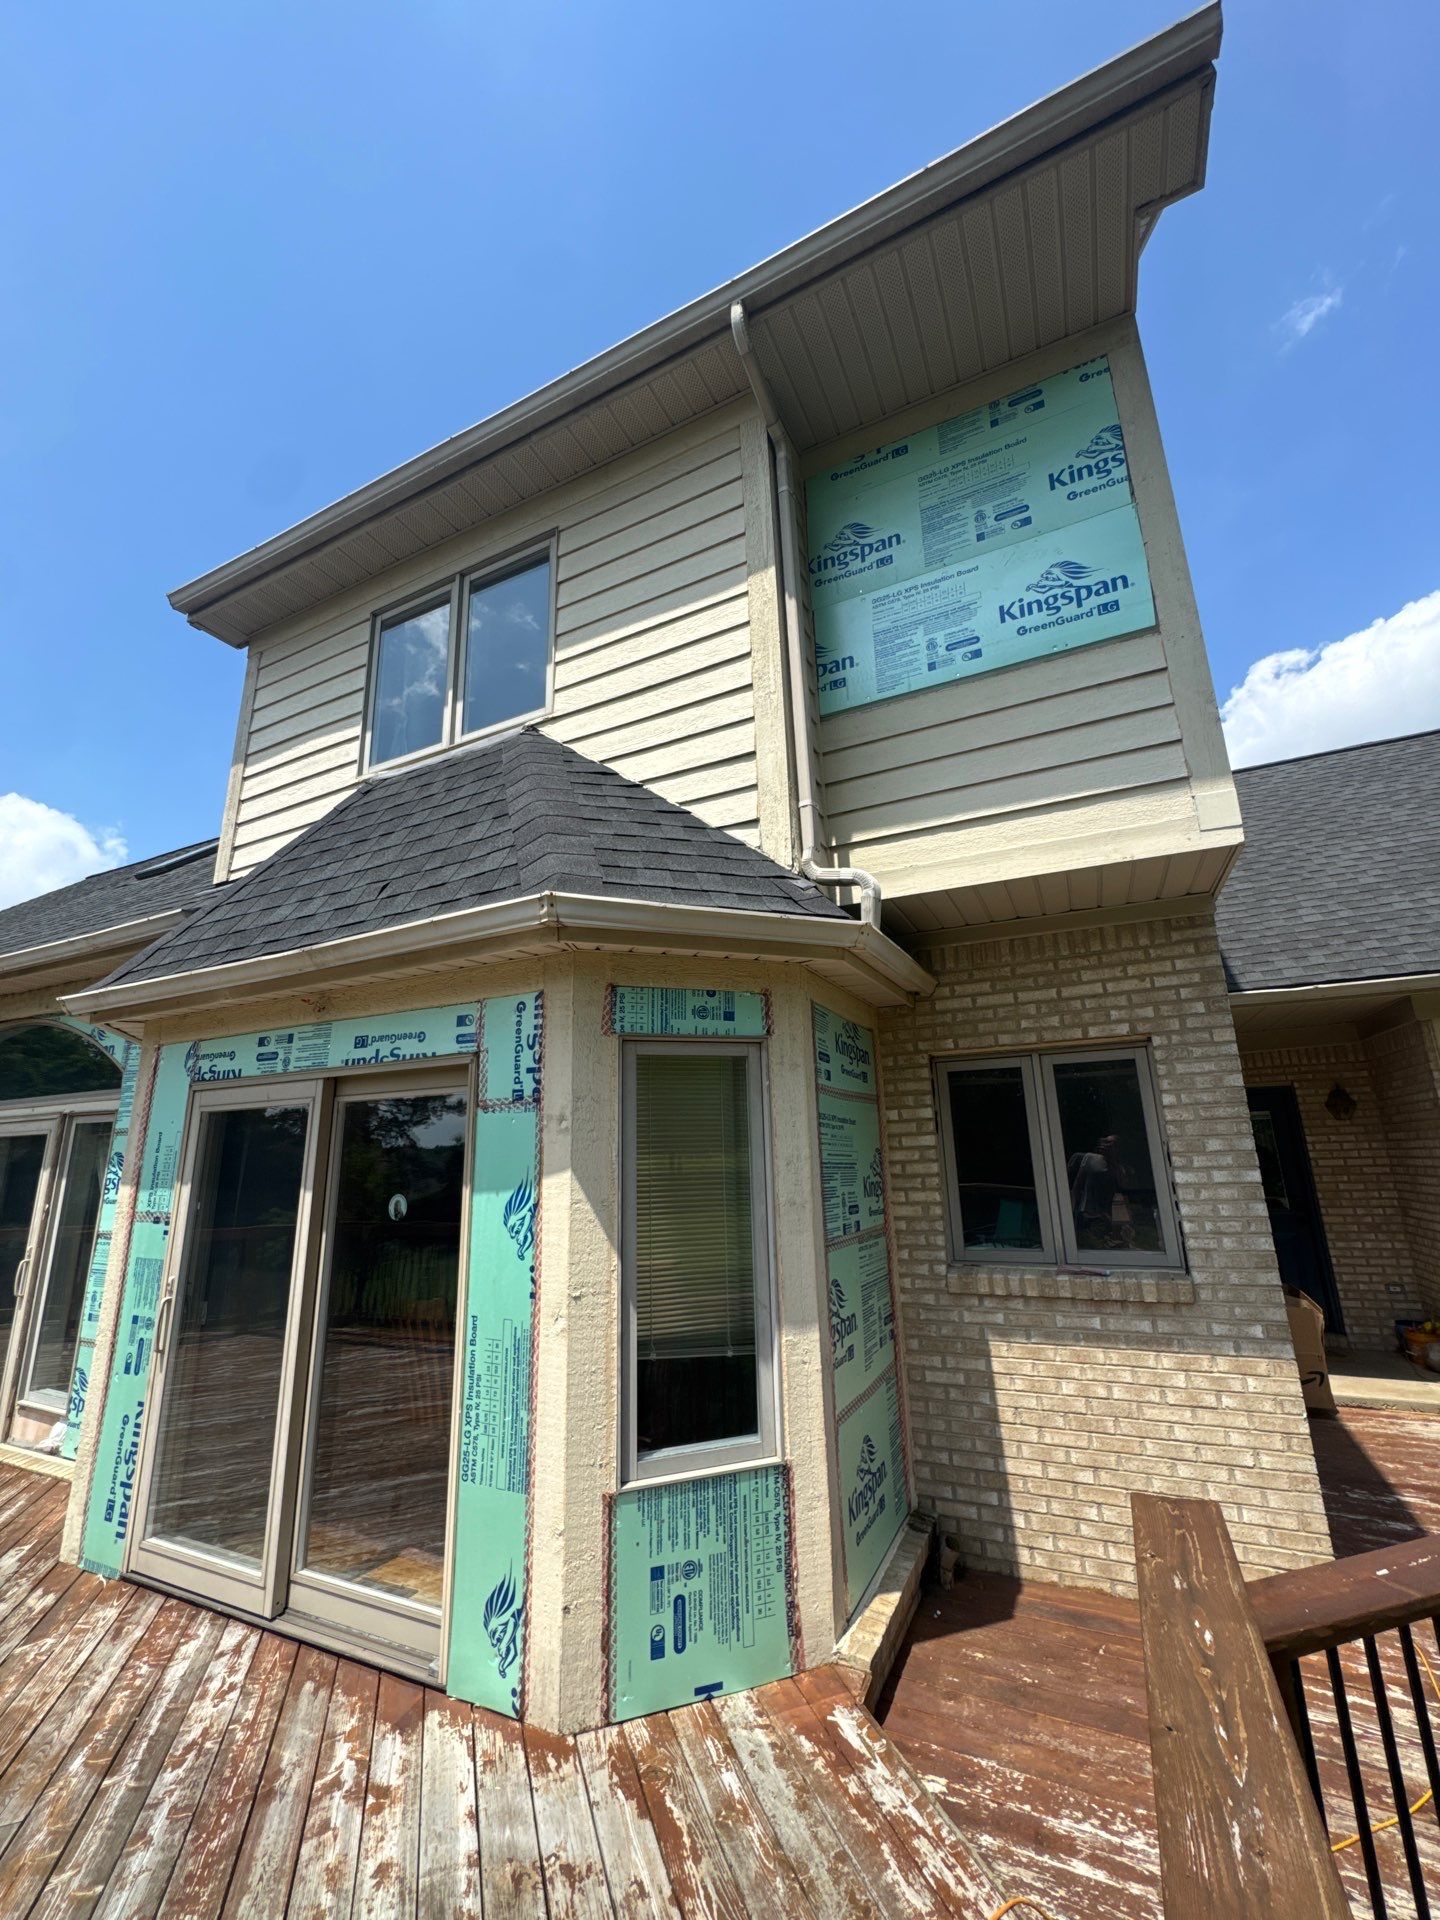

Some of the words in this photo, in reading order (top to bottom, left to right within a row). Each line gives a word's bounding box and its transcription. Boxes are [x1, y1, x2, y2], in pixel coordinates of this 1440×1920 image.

[830, 453, 889, 481] GreenGuard
[892, 445, 908, 459] LG
[950, 459, 966, 470] XPS
[967, 446, 1002, 464] Insulation
[1004, 436, 1026, 450] Board
[1048, 452, 1125, 491] Kings
[814, 565, 874, 588] GreenGuard
[876, 555, 893, 569] LG
[904, 583, 918, 593] XPS
[920, 572, 954, 588] Insulation
[956, 565, 978, 577] Board
[998, 574, 1129, 624] Kingspan
[1016, 607, 1094, 636] GreenGuard
[1098, 600, 1119, 616] LG
[830, 678, 846, 691] LG
[355, 1035, 369, 1049] LG
[371, 1031, 426, 1044] GreenGuard
[514, 1001, 526, 1085] GreenGuard
[835, 1032, 870, 1067] Kingspan
[469, 1314, 477, 1346] Board
[466, 1348, 475, 1401] Insulation
[475, 1389, 481, 1399] 25
[109, 1414, 129, 1495] GreenGuard
[461, 1429, 471, 1482] GG25-LG
[104, 1499, 115, 1522] LG
[848, 1460, 887, 1528] Kingspan
[773, 1511, 781, 1531] Type
[775, 1545, 781, 1556] 25
